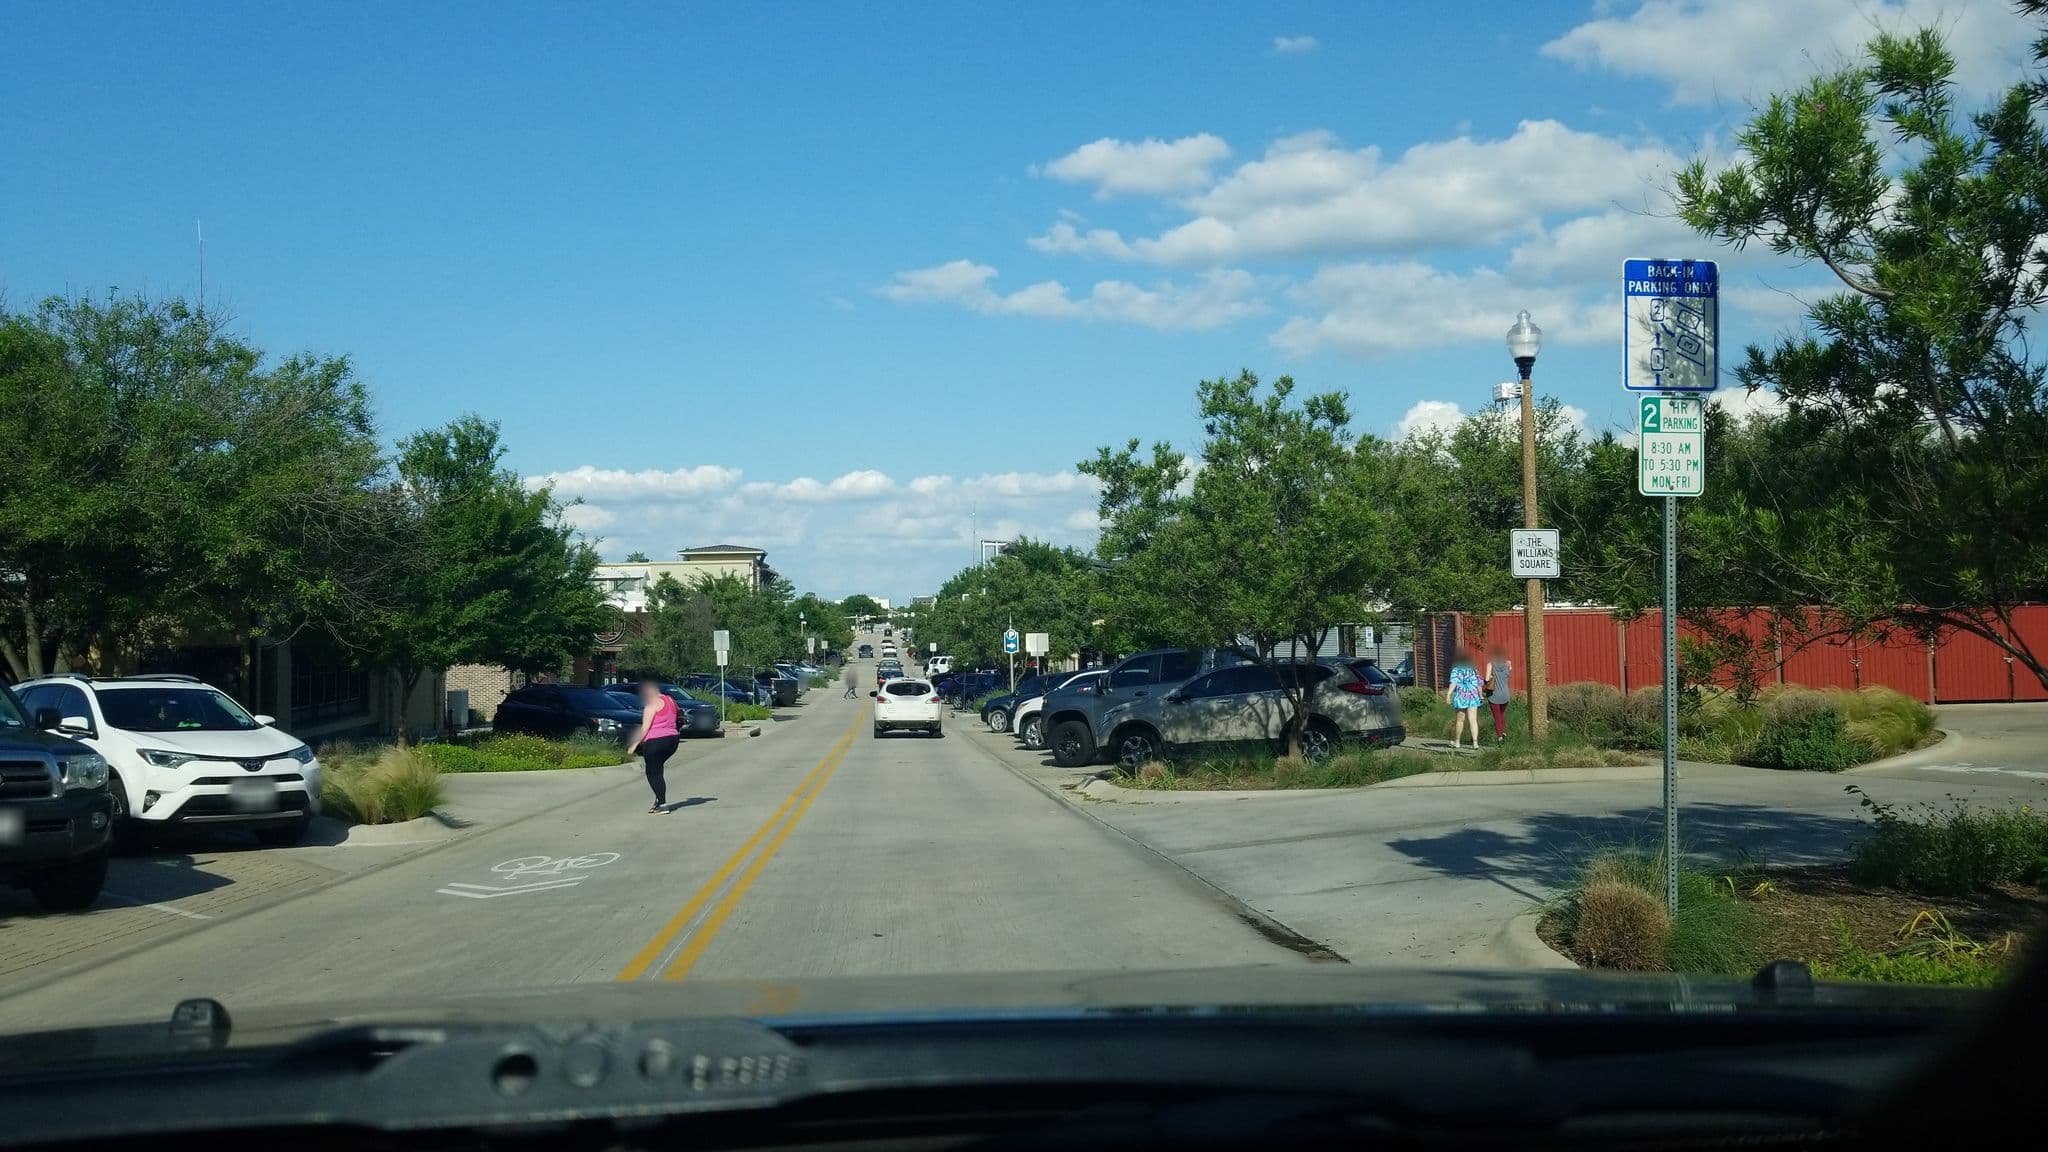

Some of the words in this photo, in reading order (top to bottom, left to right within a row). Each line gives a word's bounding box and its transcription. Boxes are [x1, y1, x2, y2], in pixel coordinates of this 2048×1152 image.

[1647, 265, 1695, 278] BACK-IN
[1628, 280, 1677, 293] PARKING
[1684, 282, 1713, 294] ONLY
[1654, 305, 1660, 315] 2
[1643, 403, 1657, 428] 2
[1672, 402, 1688, 414] HR
[1663, 417, 1698, 430] PARKING
[1651, 441, 1672, 454] 8:30
[1679, 442, 1691, 454] AM
[1643, 458, 1654, 471] TO
[1660, 458, 1681, 471] 5:30
[1686, 459, 1699, 472] PM
[1652, 475, 1691, 489] MON-FRI
[1527, 537, 1542, 547] THE
[1516, 548, 1554, 558] WILLIAMS
[1520, 559, 1551, 569] SQUARE
